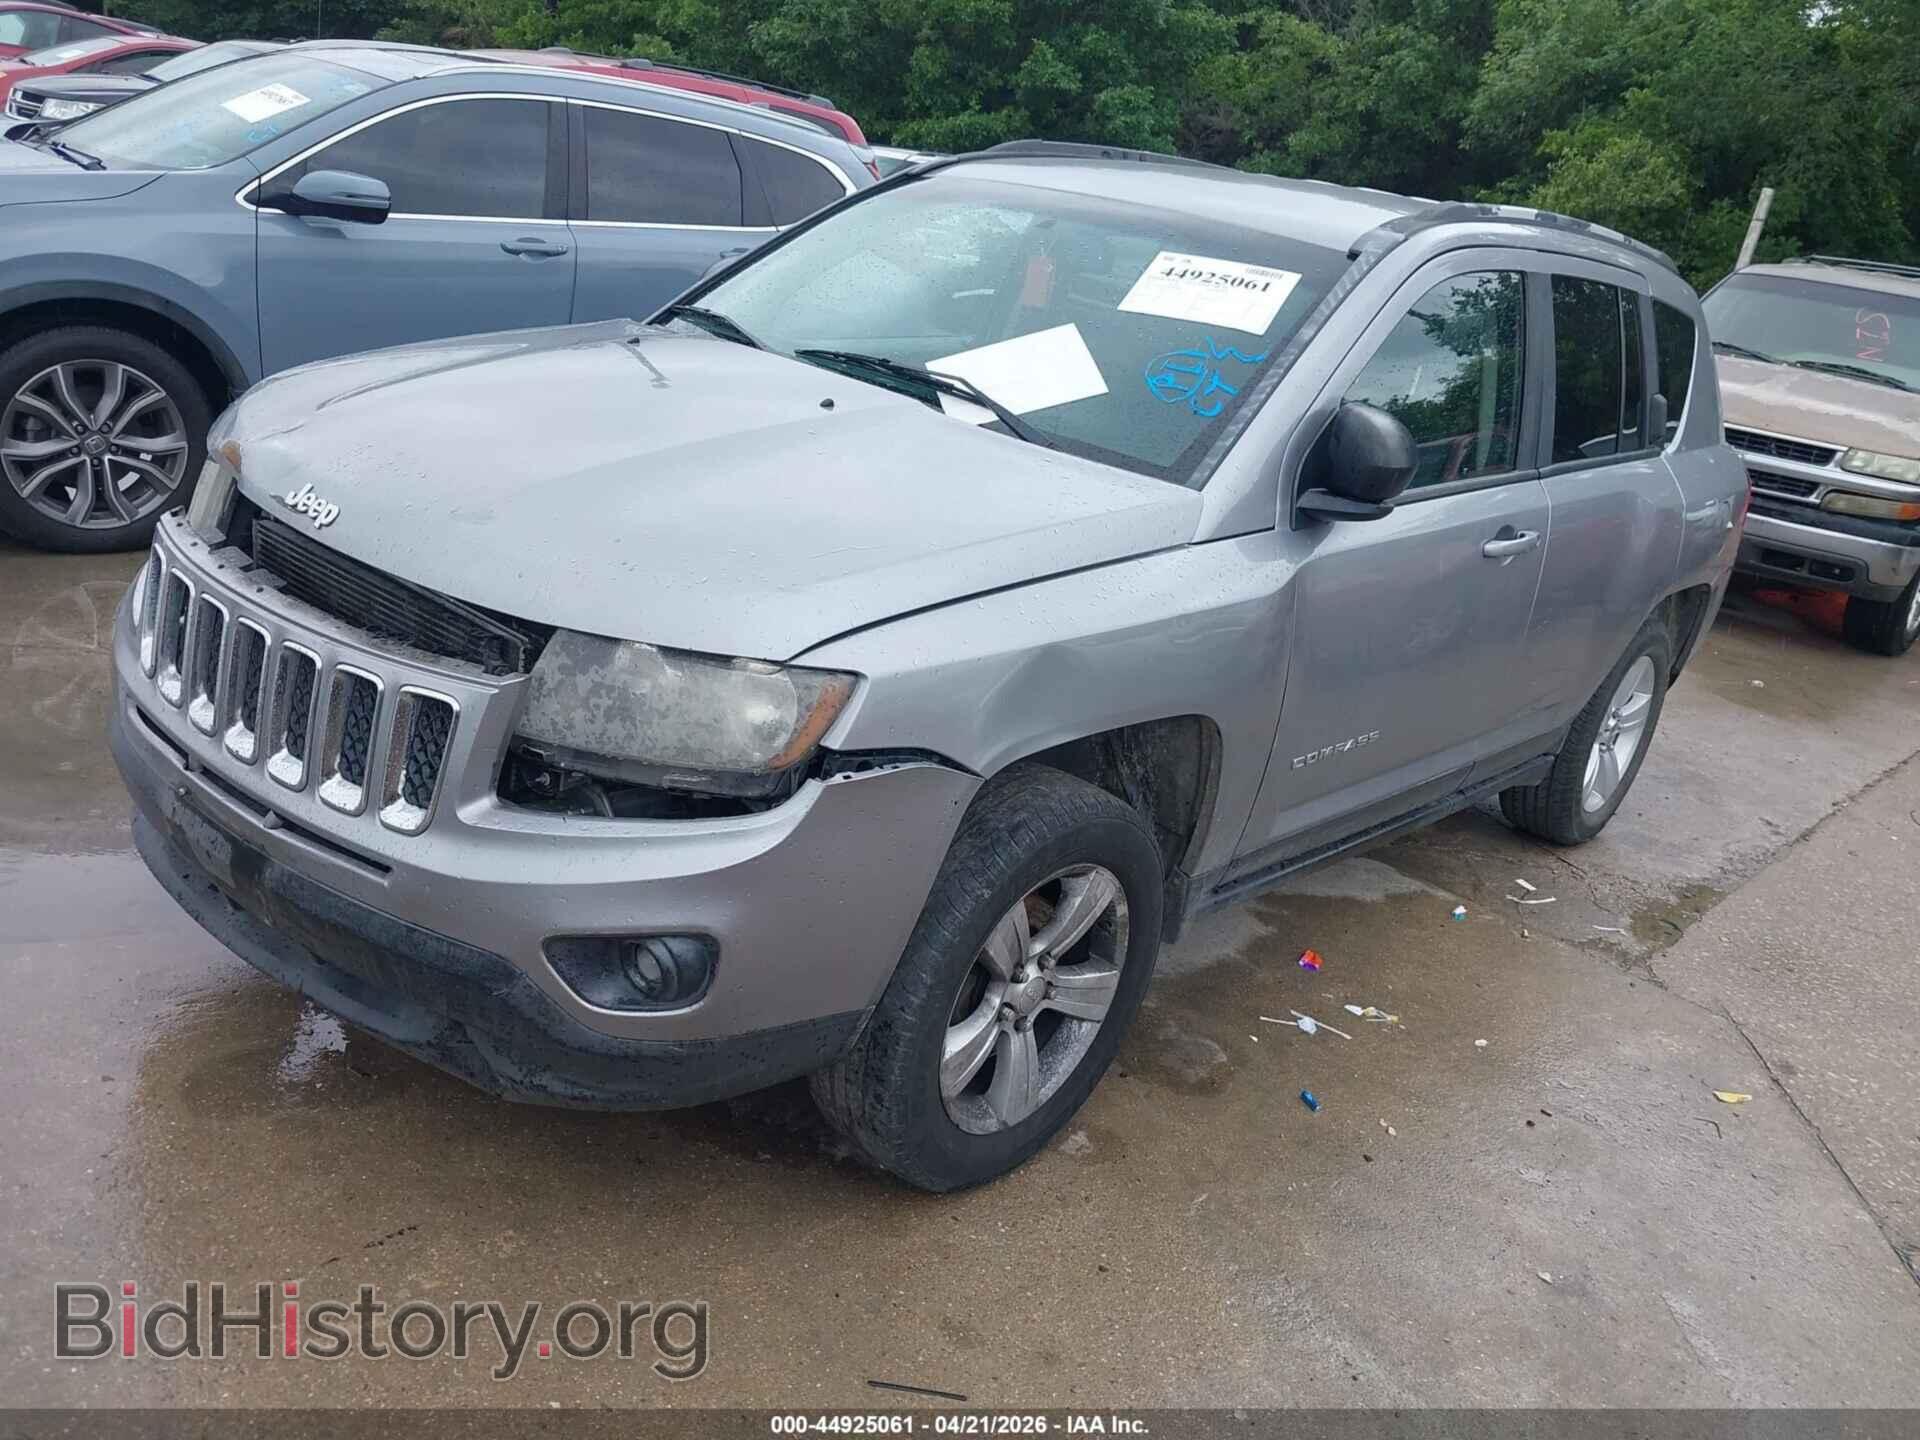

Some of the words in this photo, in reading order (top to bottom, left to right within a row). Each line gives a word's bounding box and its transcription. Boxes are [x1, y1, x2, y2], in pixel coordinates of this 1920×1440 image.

[1160, 266, 1271, 293] 44925061
[284, 482, 340, 529] Jeep
[1292, 730, 1380, 769] COMPASS
